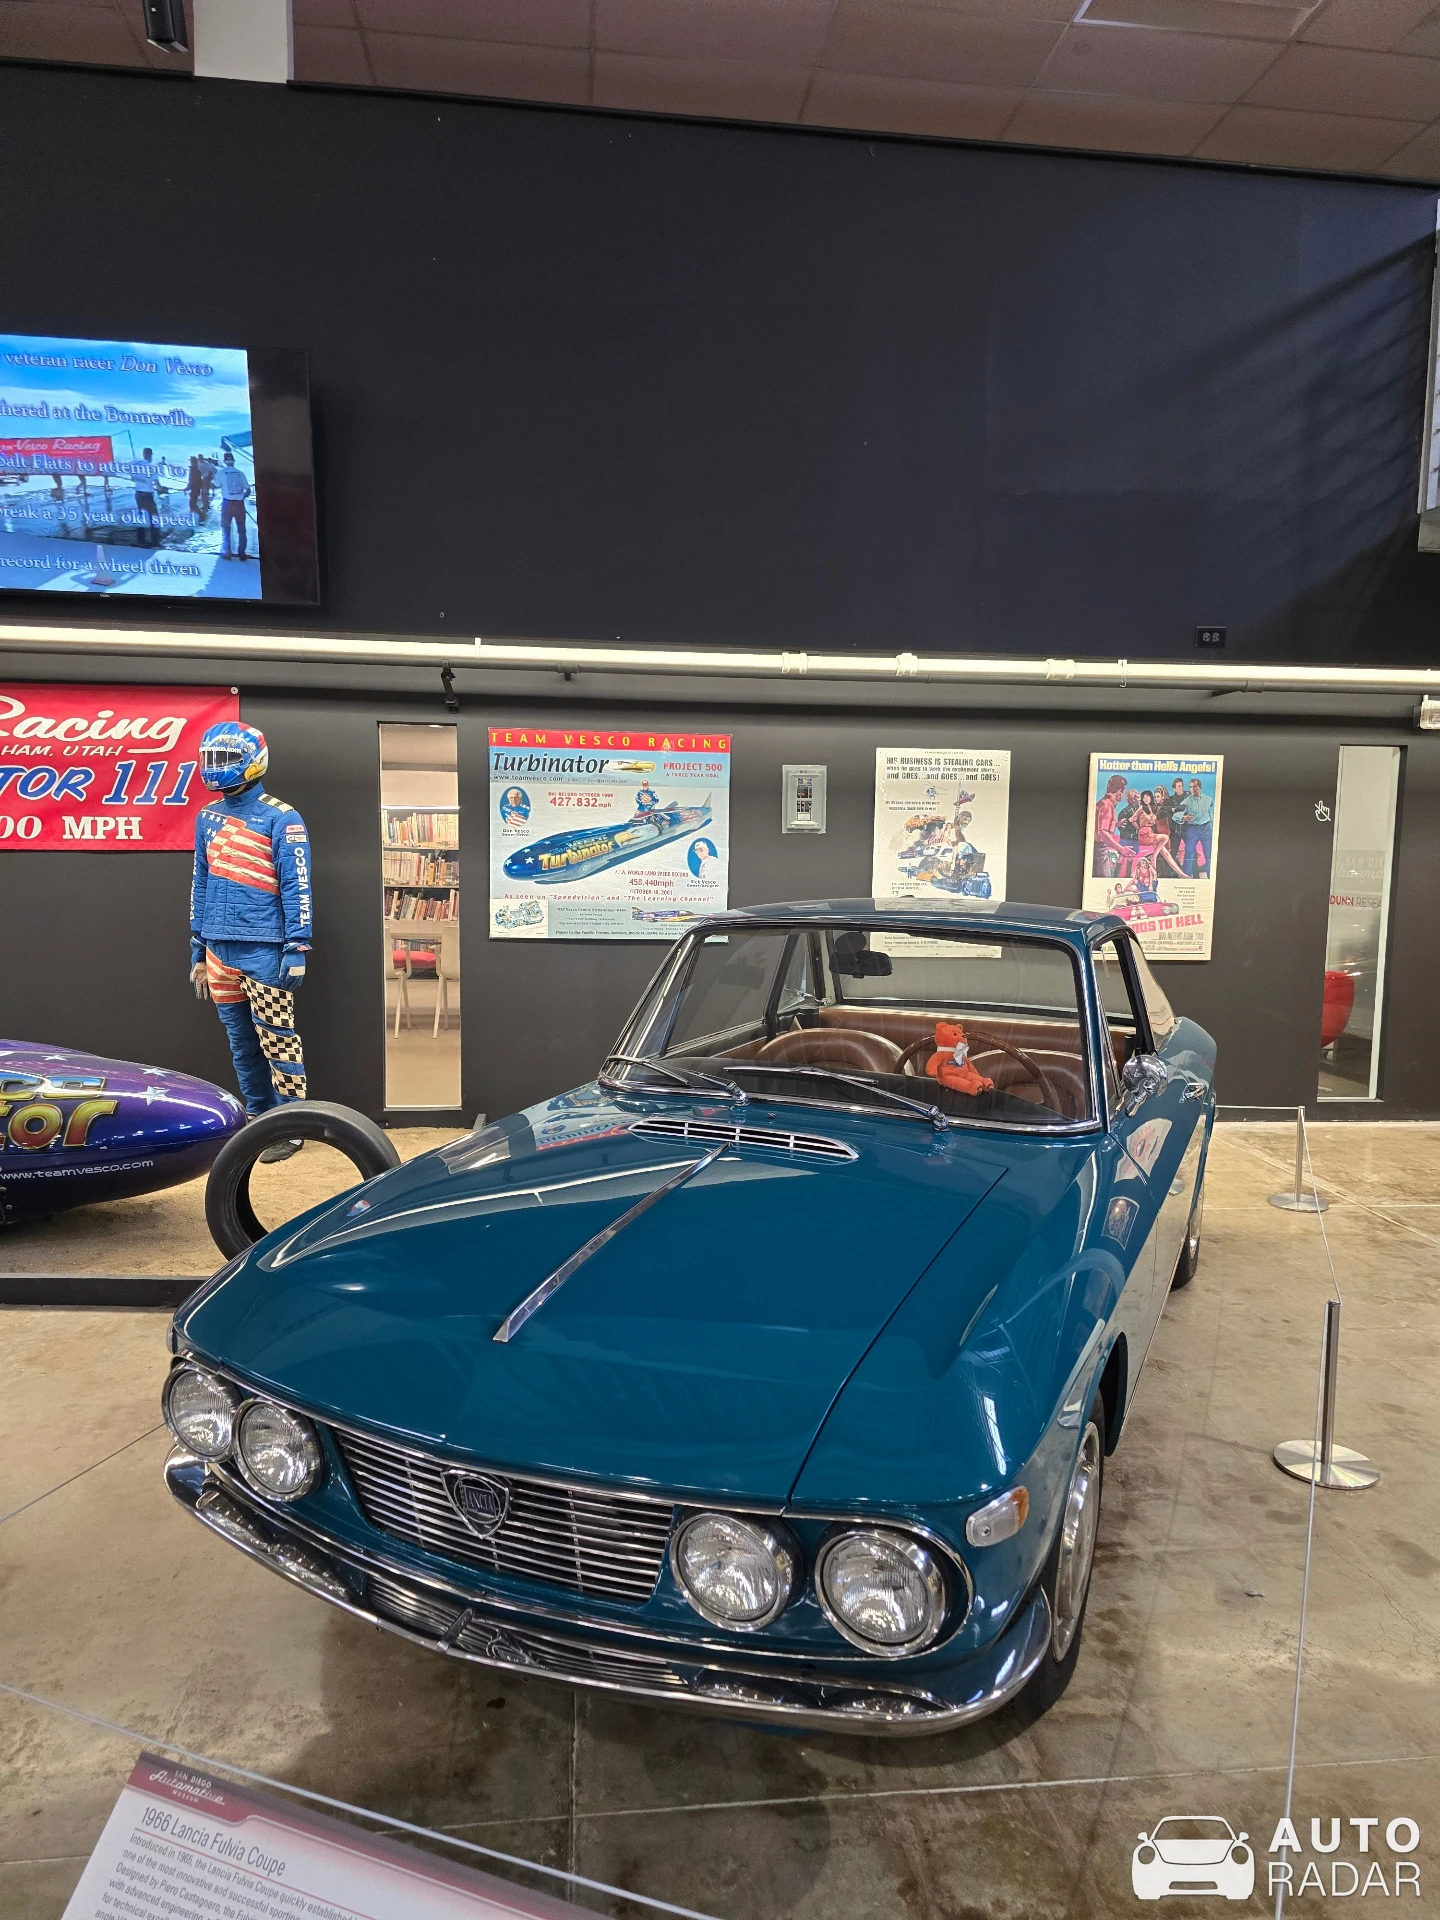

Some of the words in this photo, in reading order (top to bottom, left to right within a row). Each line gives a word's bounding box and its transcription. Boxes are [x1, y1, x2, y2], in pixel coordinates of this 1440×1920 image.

[5, 354, 68, 367] veteran
[73, 357, 114, 370] racer
[120, 356, 157, 373] Don
[164, 358, 212, 376] Vesco
[0, 400, 48, 418] hered
[52, 406, 70, 419] at
[74, 403, 100, 421] the
[105, 406, 194, 427] Bonneville
[31, 455, 71, 470] Flats
[76, 458, 94, 471] to
[99, 459, 165, 477] attempt
[167, 464, 185, 477] to
[42, 510, 52, 520] a
[57, 506, 78, 520] 35
[83, 512, 116, 526] year
[121, 509, 146, 524] old
[152, 513, 196, 531] speed
[0, 555, 50, 569] record
[56, 556, 78, 570] for
[84, 561, 94, 571] a
[98, 558, 145, 573] wheel
[149, 560, 200, 576] driven
[63, 745, 123, 756] UTAH
[491, 732, 546, 744] TEAM
[564, 734, 630, 746] VESCO
[648, 737, 726, 748] RACING
[493, 753, 610, 773] Turbinator
[664, 763, 702, 771] PROJECT
[887, 757, 898, 765] HIS
[901, 758, 932, 766] BUSINESS
[976, 759, 1000, 767] CARS...
[1100, 760, 1130, 770] Hotter
[1131, 761, 1152, 770] than
[1179, 762, 1216, 774] Angels!
[887, 772, 899, 780] and
[62, 816, 143, 840] MPH
[295, 847, 308, 892] VESCO
[300, 894, 310, 927] TEAM
[1330, 895, 1354, 906] DUNN
[1129, 921, 1156, 934] ODS
[1158, 918, 1172, 930] TO
[1176, 914, 1204, 927] HELL
[149, 1770, 225, 1805] Automotive
[175, 1770, 189, 1780] SAN
[190, 1775, 212, 1788] DIEGO
[172, 1789, 199, 1803] MUSEUM
[142, 1806, 171, 1832] 1966
[171, 1817, 210, 1847] Lancia
[210, 1833, 245, 1861] Fulvia
[248, 1846, 286, 1877] Coupe
[122, 1850, 136, 1861] one
[137, 1852, 146, 1864] of
[145, 1857, 157, 1869] the
[158, 1863, 176, 1877] most
[176, 1867, 212, 1891] innovative
[214, 1885, 229, 1897] and
[228, 1891, 270, 1913] successful
[130, 1833, 167, 1855] Introduced
[168, 1848, 176, 1859] in
[177, 1849, 193, 1867] 1965,
[195, 1859, 207, 1871] the
[207, 1862, 231, 1880] Lancia
[232, 1872, 254, 1889] Fulvia
[255, 1881, 279, 1899] Coupe
[280, 1892, 307, 1911] quickly
[109, 1879, 125, 1892] with
[125, 1886, 161, 1906] advanced
[116, 1862, 150, 1883] Designed
[149, 1876, 160, 1889] by
[159, 1879, 178, 1896] Piero
[180, 1887, 221, 1914] Castagnero,
[223, 1906, 236, 1918] the
[102, 1892, 112, 1904] for
[113, 1898, 147, 1918] technical
